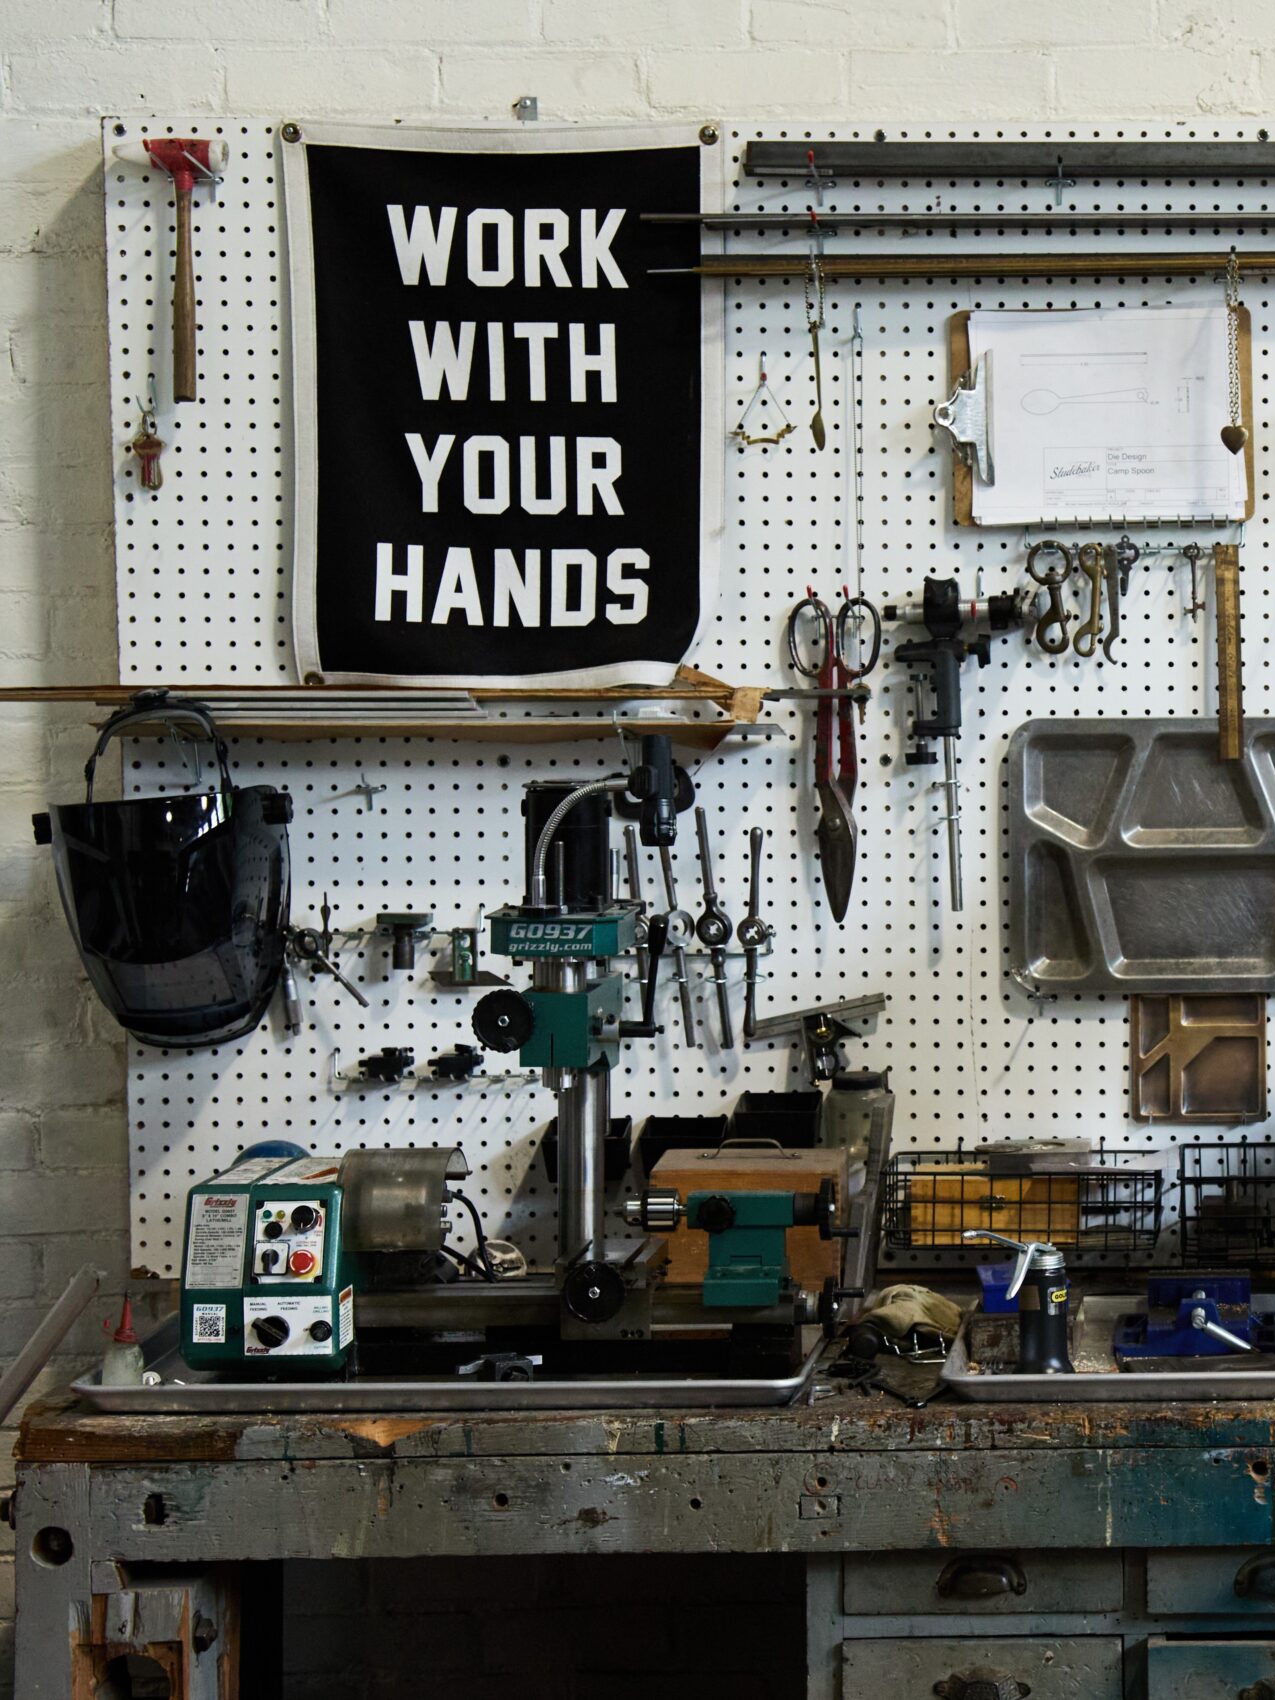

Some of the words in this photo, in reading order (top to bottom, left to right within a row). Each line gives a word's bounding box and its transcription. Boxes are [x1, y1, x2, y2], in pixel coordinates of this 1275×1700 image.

[387, 205, 628, 288] WORK
[409, 321, 616, 402] WITH
[1122, 453, 1148, 462] Design
[405, 434, 624, 515] YOUR
[1050, 462, 1100, 480] Studebaker
[1108, 467, 1130, 475] Camp
[1131, 467, 1155, 476] Spoon
[375, 543, 649, 627] HANDS
[510, 924, 592, 940] G0937
[509, 942, 592, 952] grizzly.com
[204, 1197, 238, 1207] Grizzly
